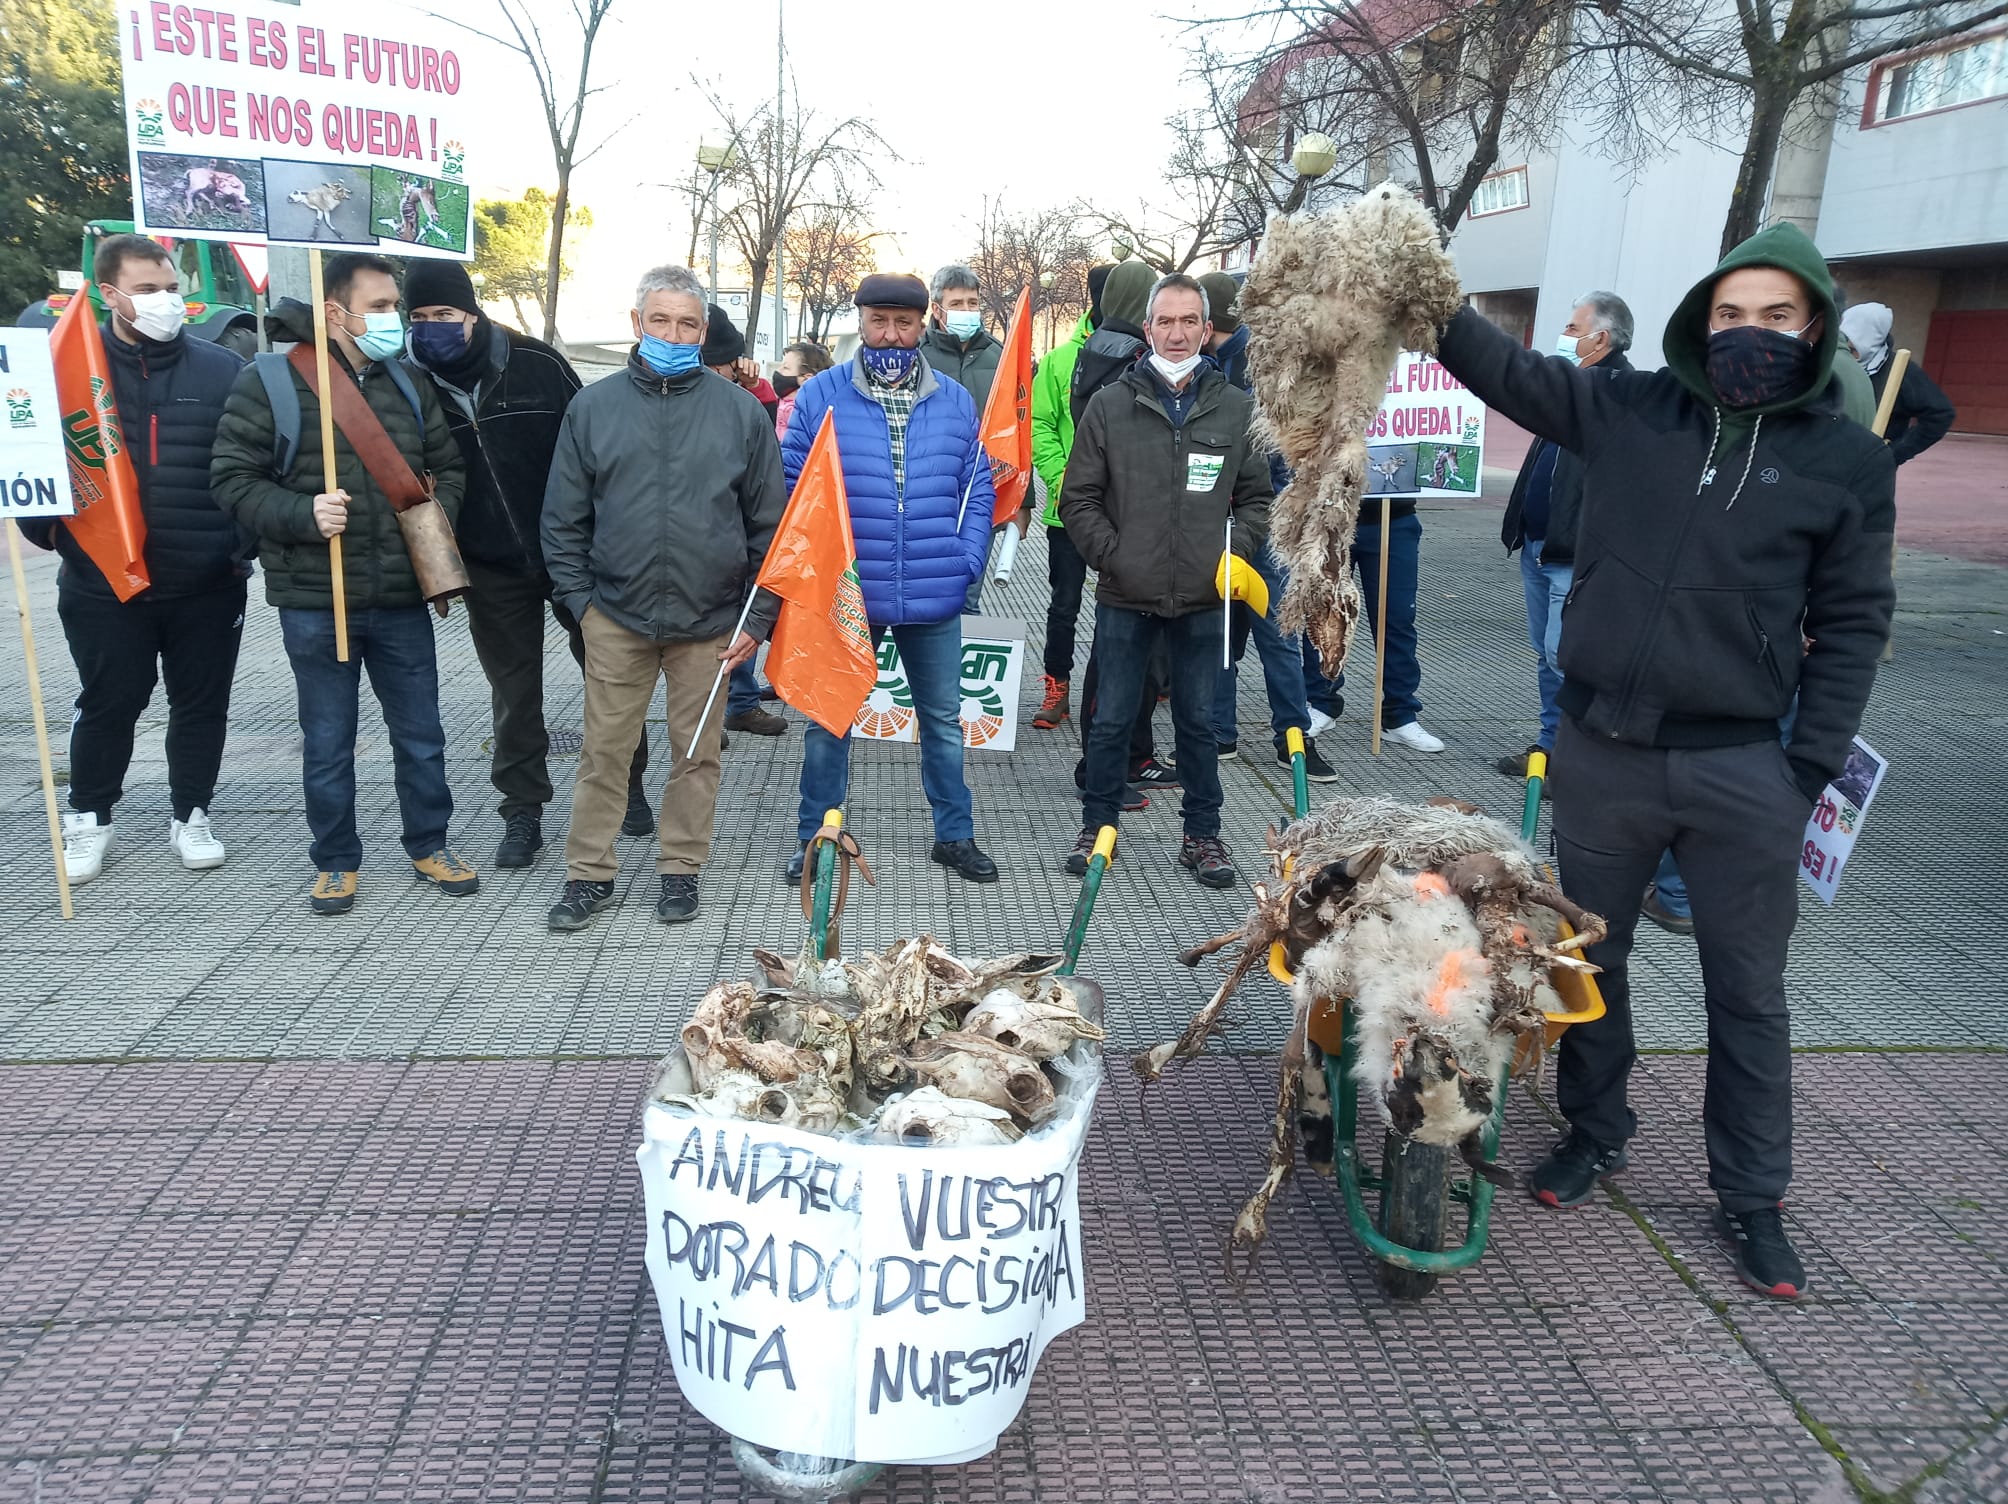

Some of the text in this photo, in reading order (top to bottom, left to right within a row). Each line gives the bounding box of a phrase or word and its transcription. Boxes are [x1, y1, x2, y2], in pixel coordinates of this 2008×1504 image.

[151, 1, 238, 63] ESTE
[247, 17, 288, 70] ES
[297, 25, 335, 77] EL
[344, 33, 461, 95] FUTURO
[167, 82, 239, 138] QUE
[247, 92, 313, 147] NOS
[322, 103, 423, 160] QUEDA
[1392, 407, 1452, 438] QUEDA
[0, 471, 58, 508] IÓN
[1802, 839, 1826, 881] ES
[669, 1126, 862, 1215] ANDREU
[662, 1210, 860, 1311] DORADO
[869, 1331, 1032, 1414] NUESTRA
